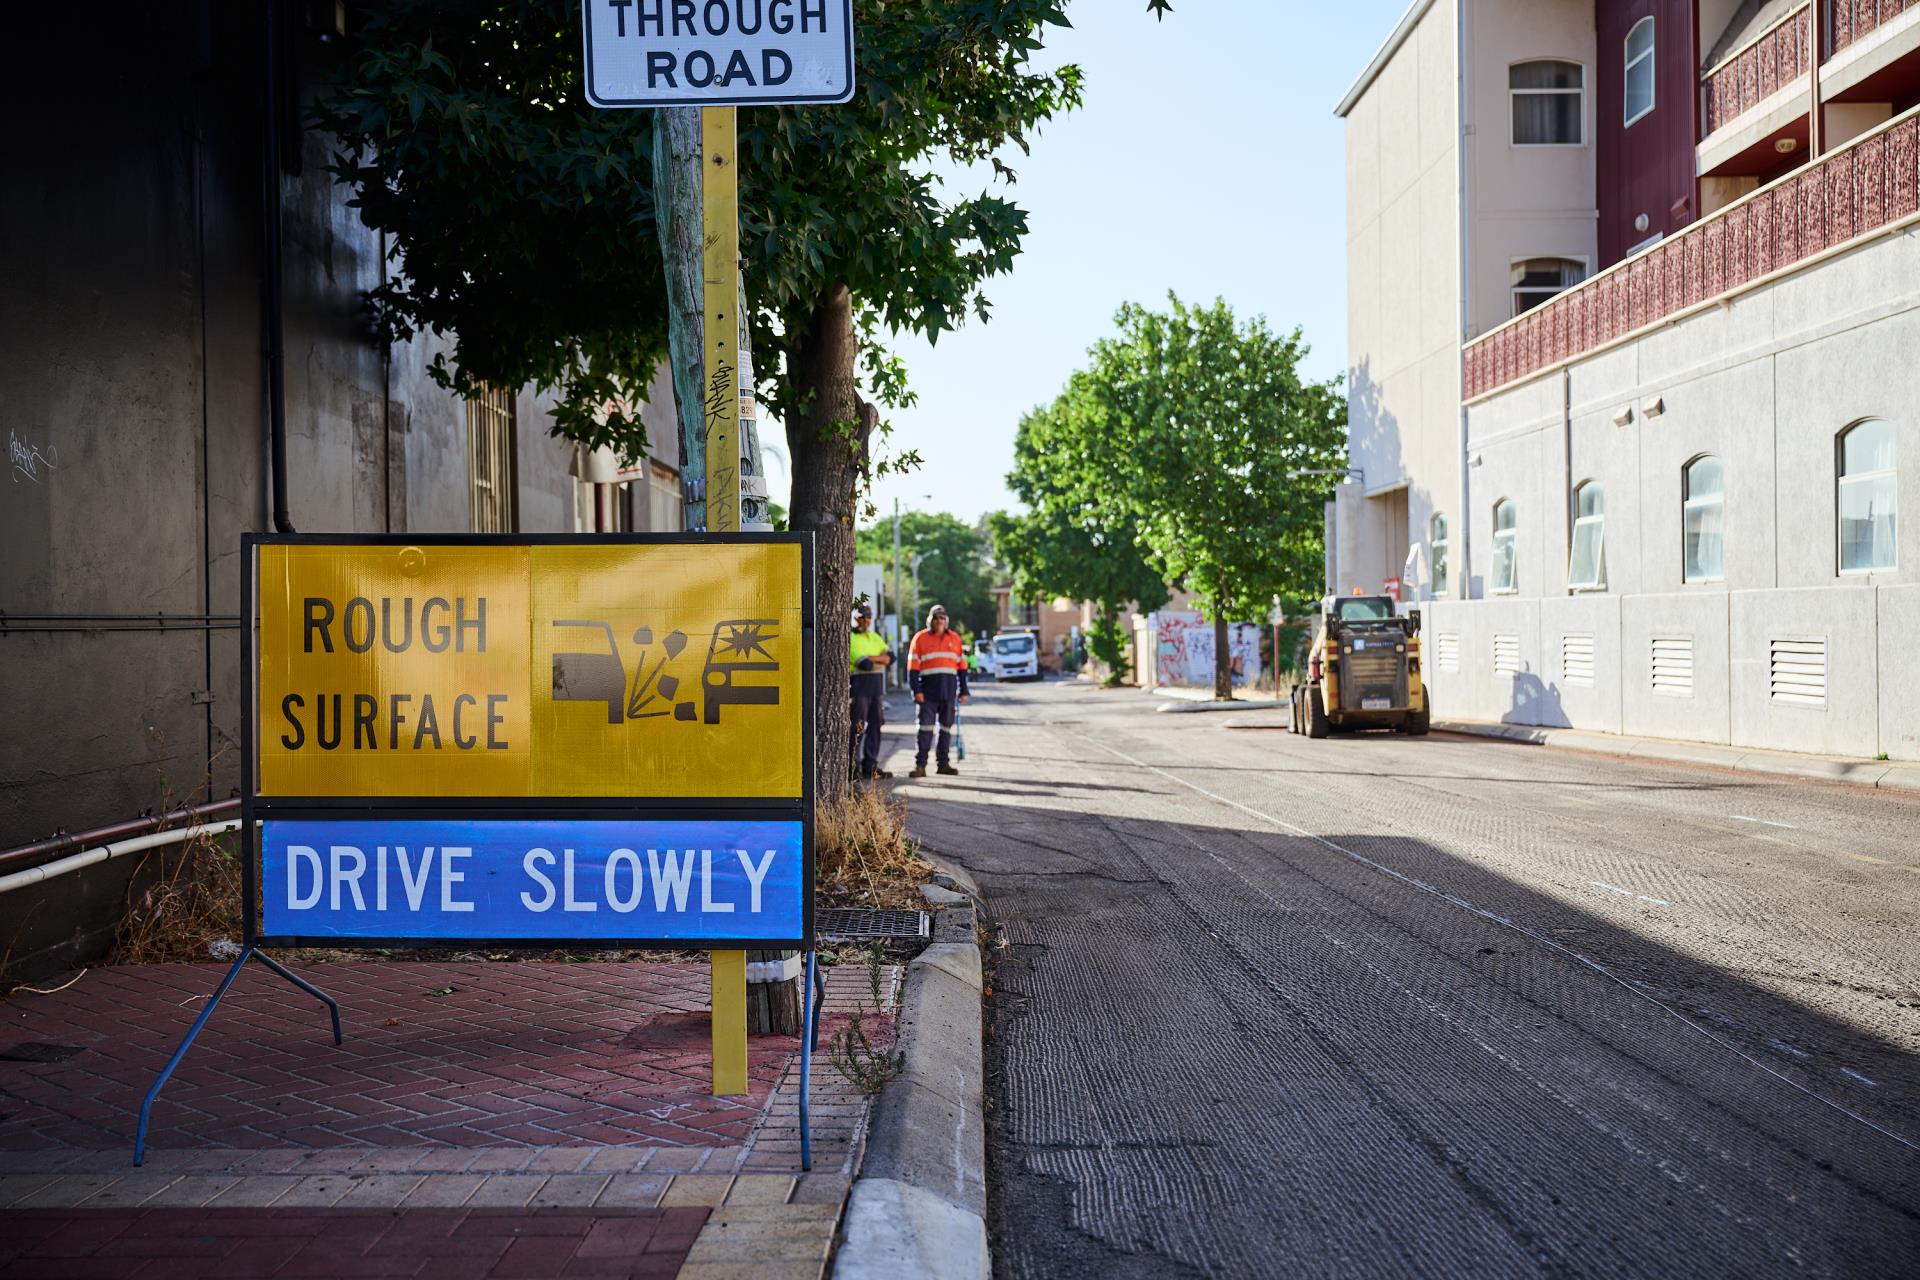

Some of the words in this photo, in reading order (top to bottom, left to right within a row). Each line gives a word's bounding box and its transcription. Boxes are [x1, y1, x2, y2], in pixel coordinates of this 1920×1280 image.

[609, 0, 827, 37] THROUGH
[647, 49, 793, 89] ROAD
[303, 596, 487, 653] ROUGH
[281, 693, 509, 751] SURFACE
[286, 845, 475, 912] DRIVE
[520, 848, 777, 914] SLOWLY
